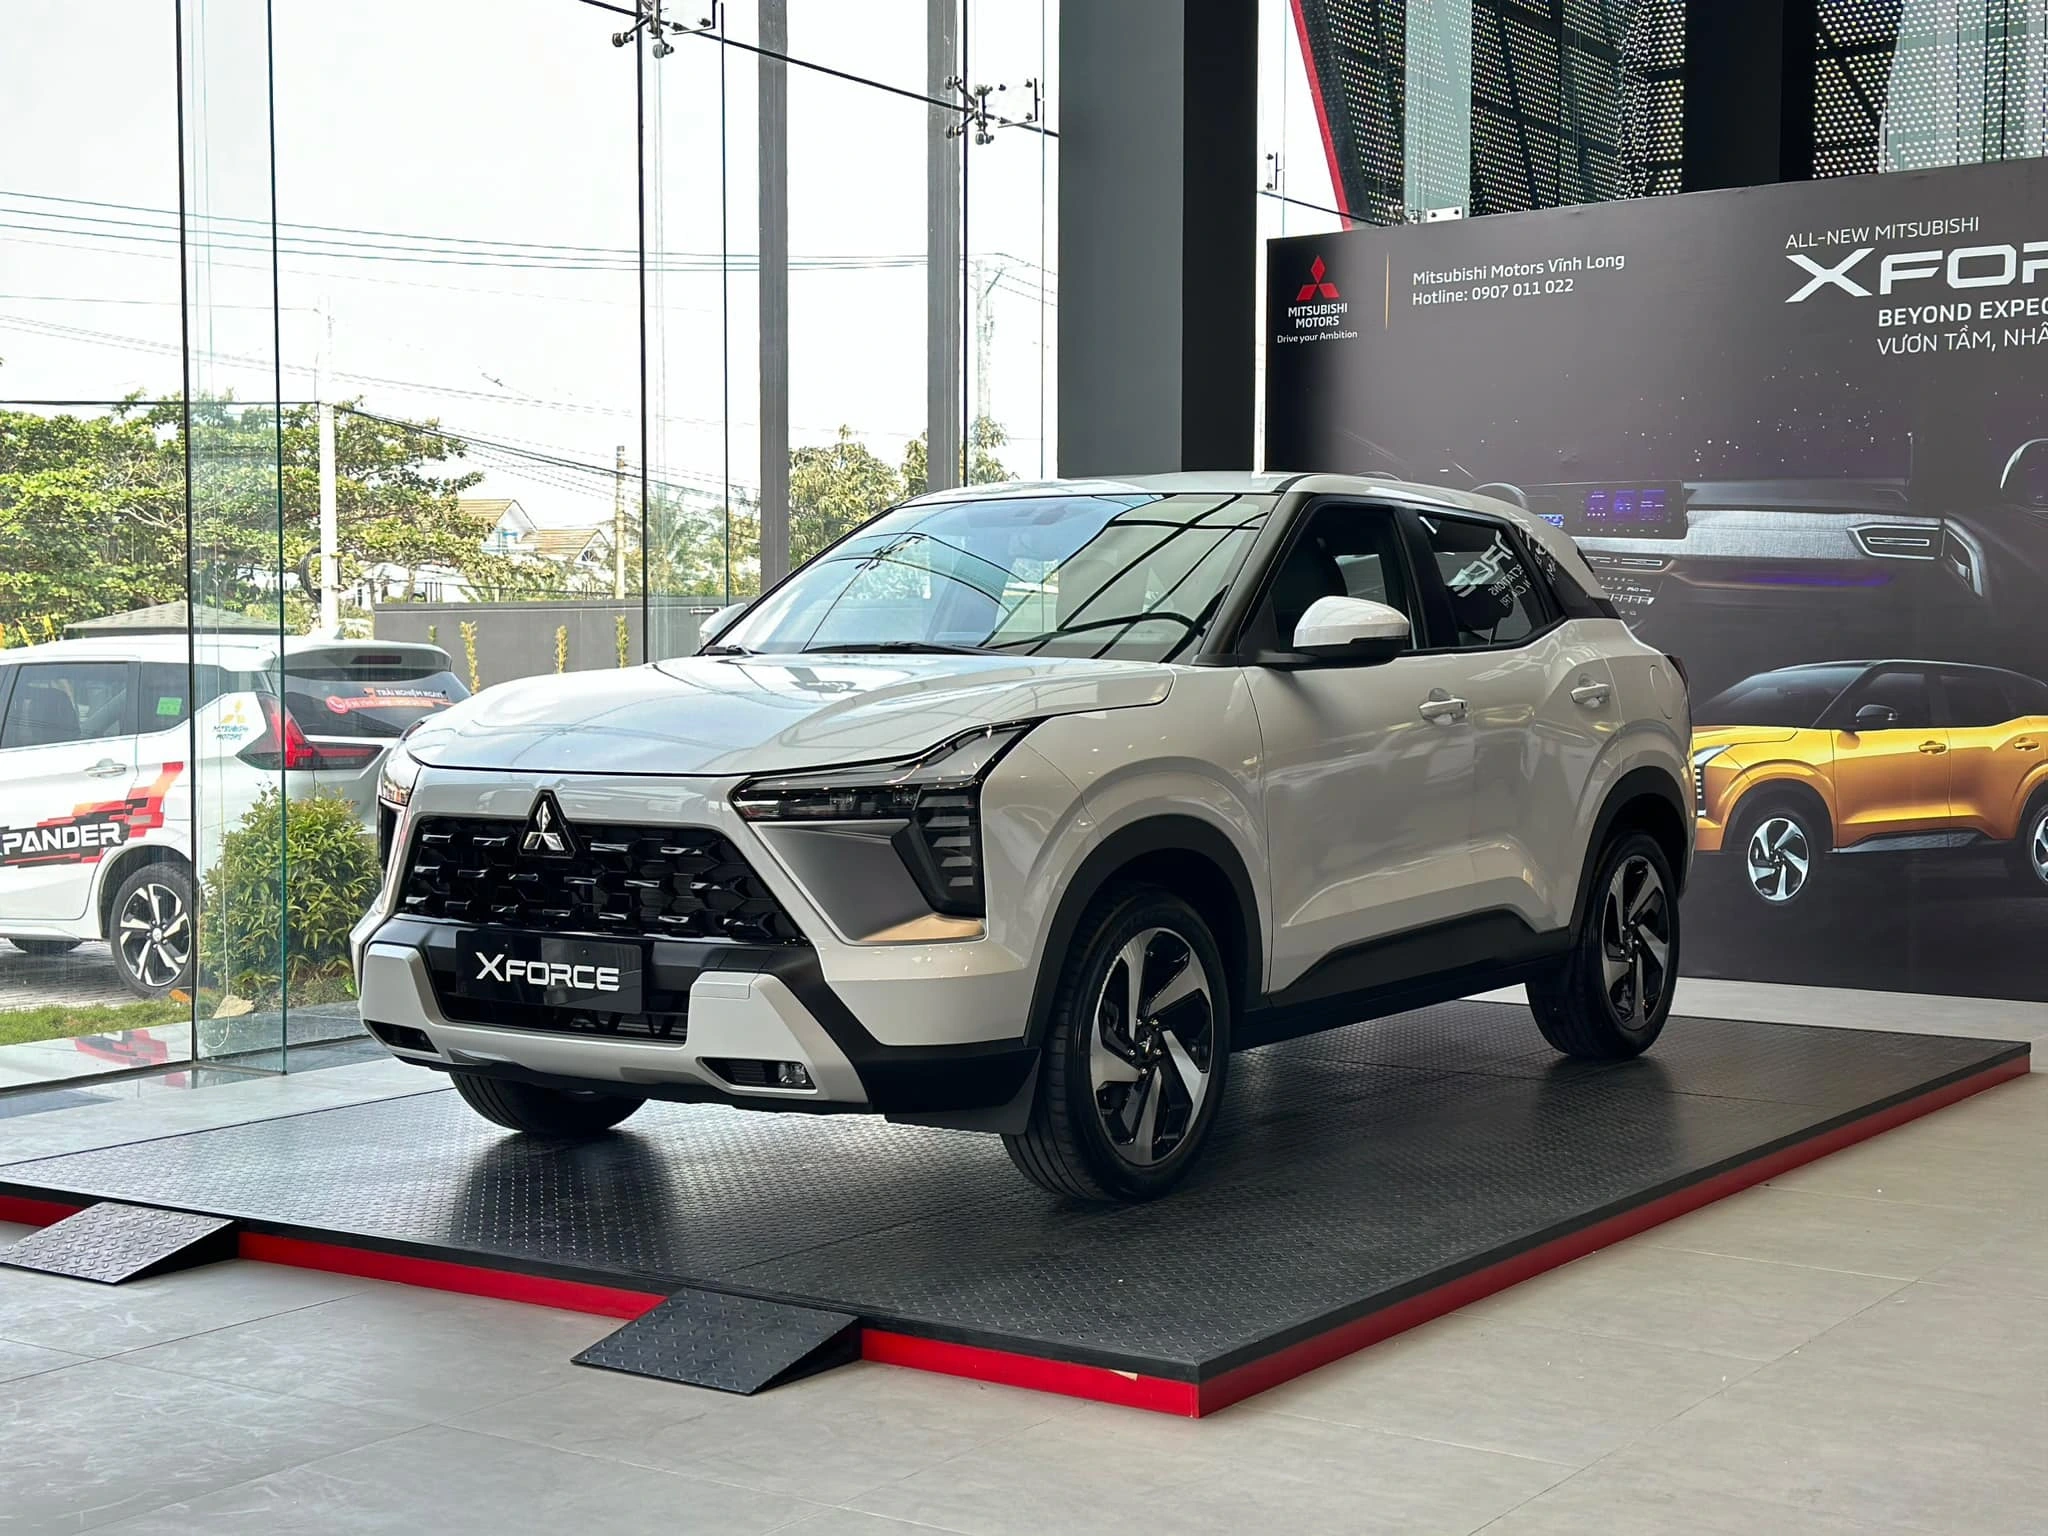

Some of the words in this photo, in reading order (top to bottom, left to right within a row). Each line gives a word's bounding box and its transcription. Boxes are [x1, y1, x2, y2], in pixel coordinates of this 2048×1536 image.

[1785, 227, 1870, 249] ALL-NEW
[1875, 216, 1980, 241] MITSUBISHI
[1412, 266, 1487, 286] Mitsubishi
[1491, 262, 1544, 279] Motors
[1548, 256, 1582, 274] Vĩnh
[1586, 254, 1625, 270] Long
[1412, 288, 1468, 306] Hotline:
[1471, 284, 1509, 301] 0907
[1513, 281, 1542, 297] 011
[1545, 278, 1574, 294] 022
[1288, 302, 1348, 318] MITSUBISHI
[1295, 315, 1340, 329] MOTORS
[1878, 303, 1972, 328] BEYOND
[1277, 334, 1299, 344] Drive
[1300, 334, 1318, 344] your
[1319, 330, 1358, 341] Ambition
[1877, 333, 1937, 355] VƯƠN
[0, 822, 122, 856] PANDER
[475, 951, 620, 992] XFORCE
